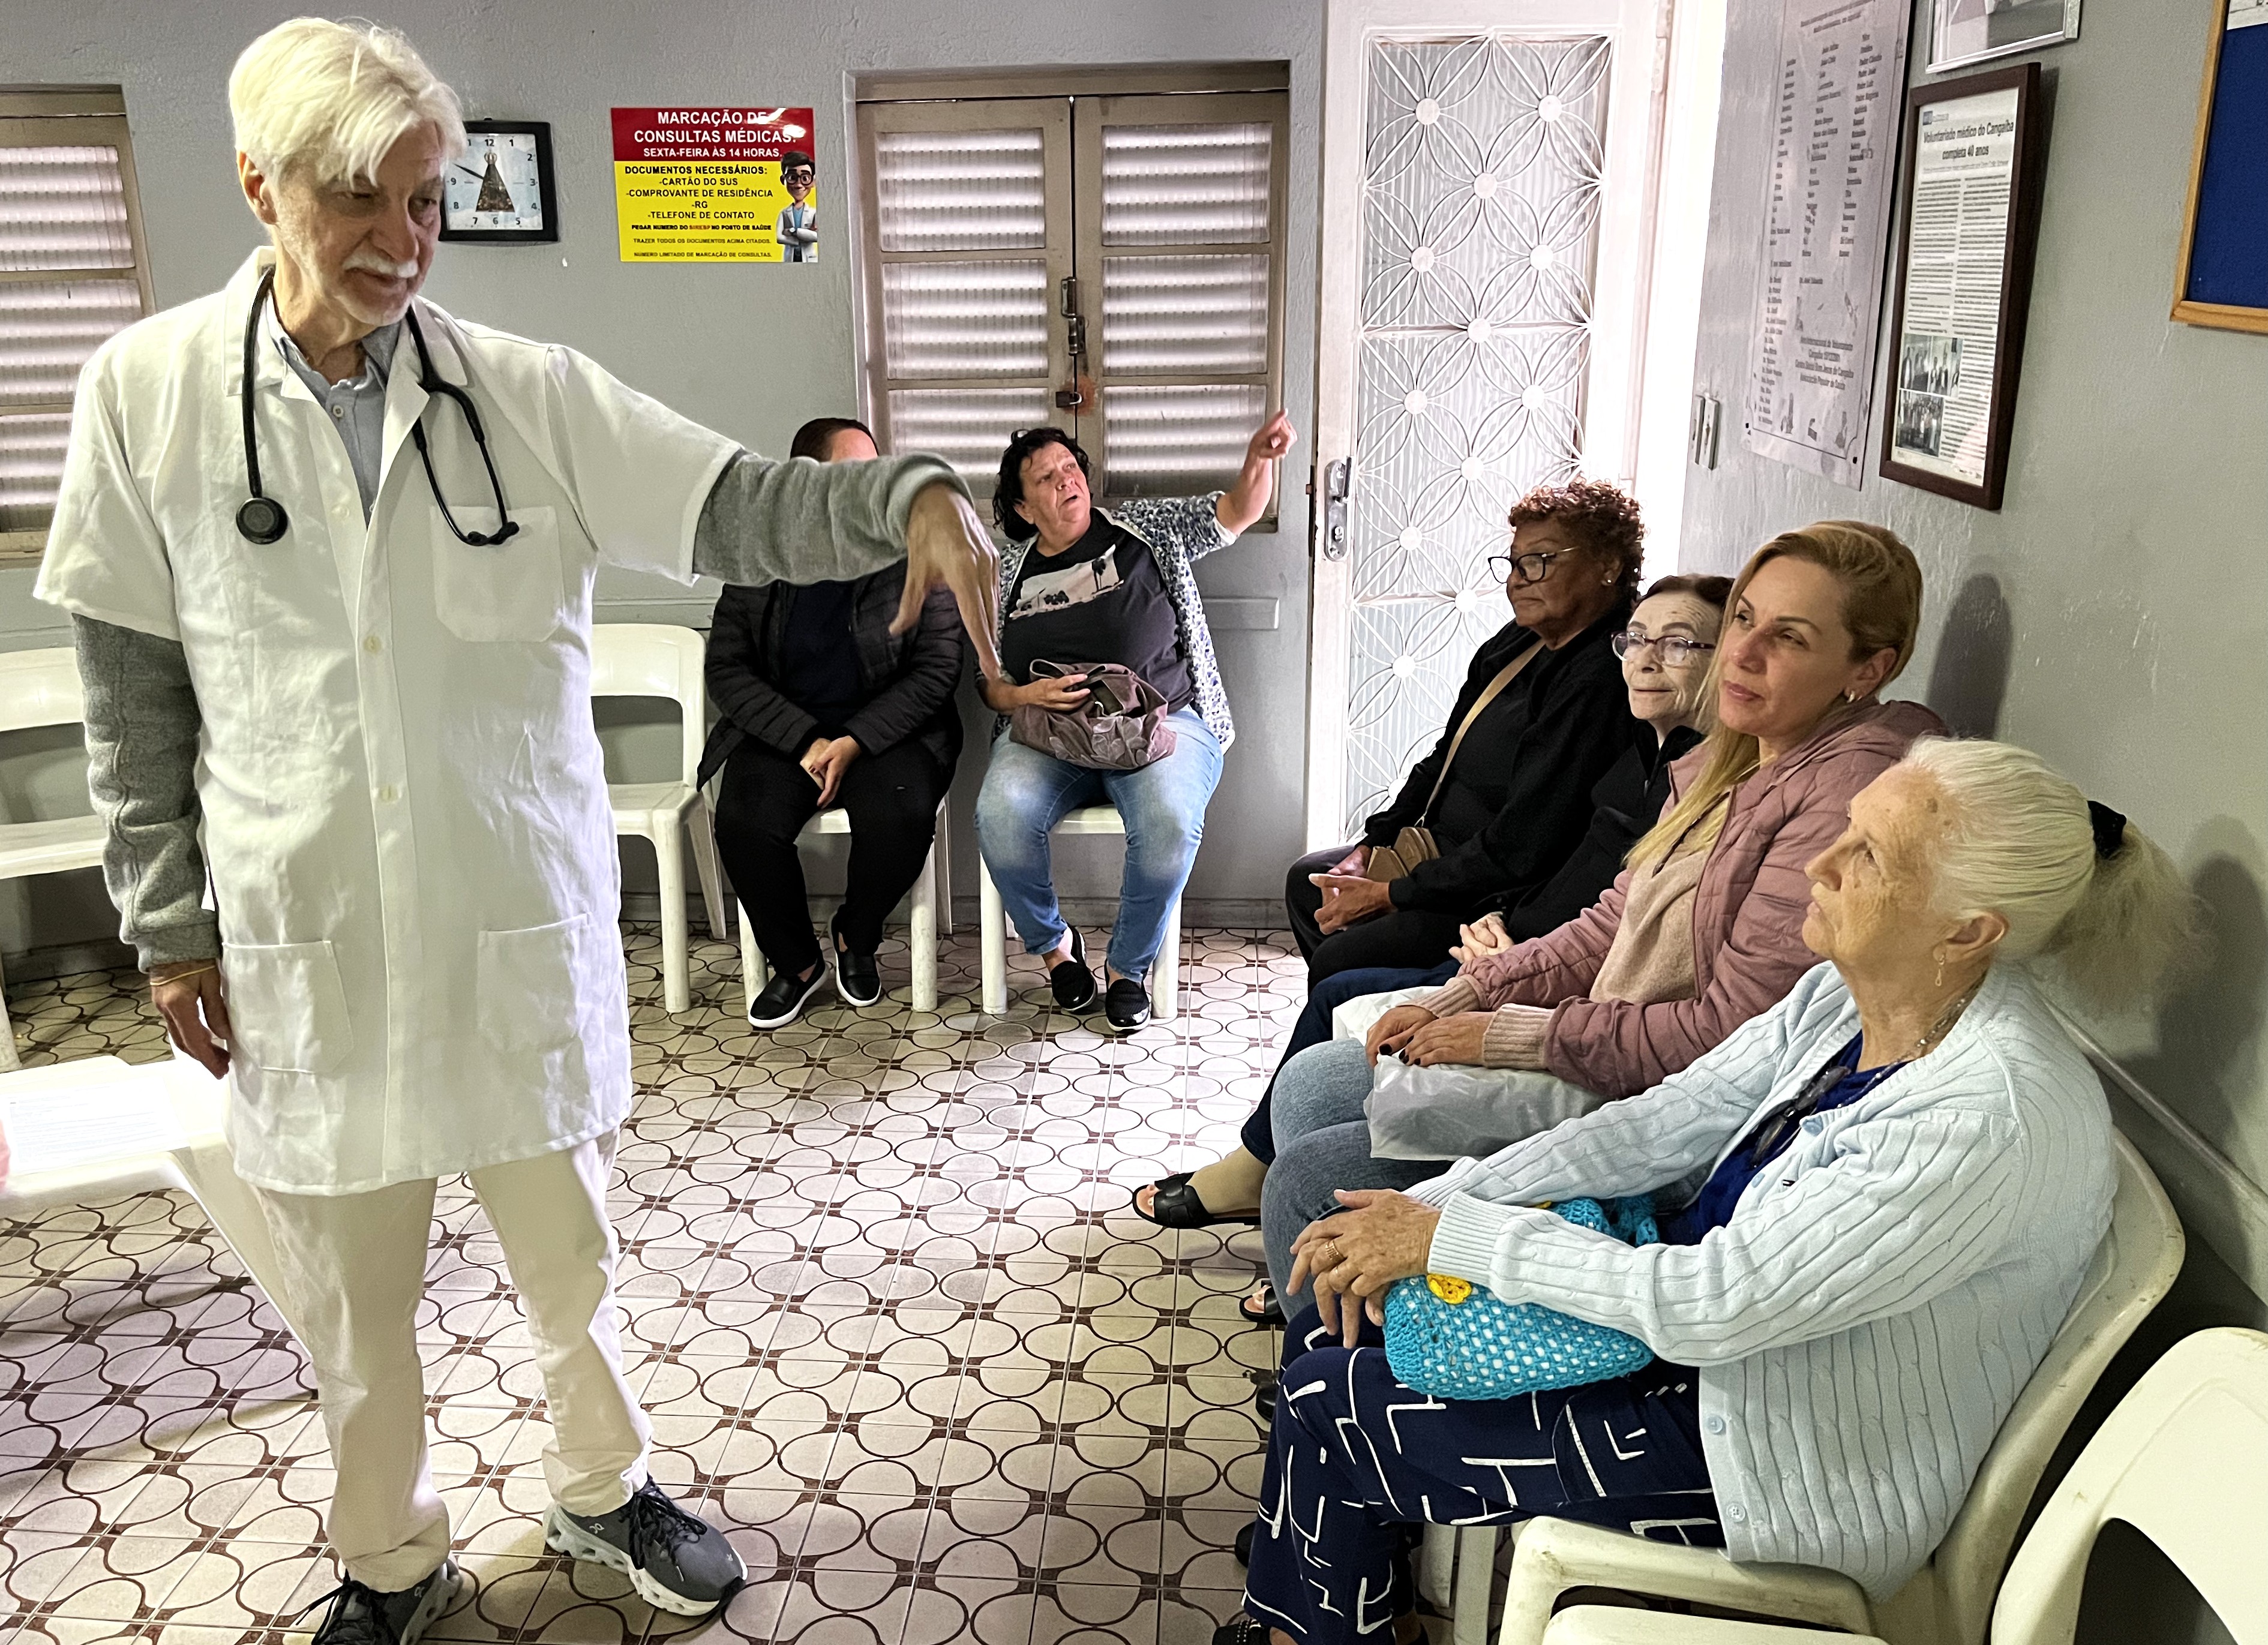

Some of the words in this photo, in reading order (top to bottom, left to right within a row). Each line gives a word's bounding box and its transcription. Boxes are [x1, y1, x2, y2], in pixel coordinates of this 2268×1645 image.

[658, 109, 743, 127] MARCAÇÃO
[1978, 124, 1985, 136] do
[634, 130, 721, 143] CONSULTAS
[484, 139, 495, 147] 12
[644, 148, 710, 157] SEXTA-FEIRA
[712, 145, 727, 157] ÀS
[729, 148, 740, 157] 14
[743, 148, 782, 157] HORAS.
[1975, 146, 1989, 156] anos
[527, 154, 533, 162] 2
[625, 166, 692, 175] DOCUMENTOS
[695, 164, 767, 175] NECESSÁRIOS:
[530, 178, 536, 187] 3
[659, 176, 701, 186] -CARTÃO
[703, 178, 717, 186] DO
[719, 178, 739, 186] SUS
[626, 189, 699, 197] -COMPROVANTE
[702, 189, 715, 197] DE
[717, 187, 773, 197] RESIDÊNCIA
[472, 217, 478, 225] 7
[493, 217, 499, 225] 6
[515, 217, 521, 225] 5
